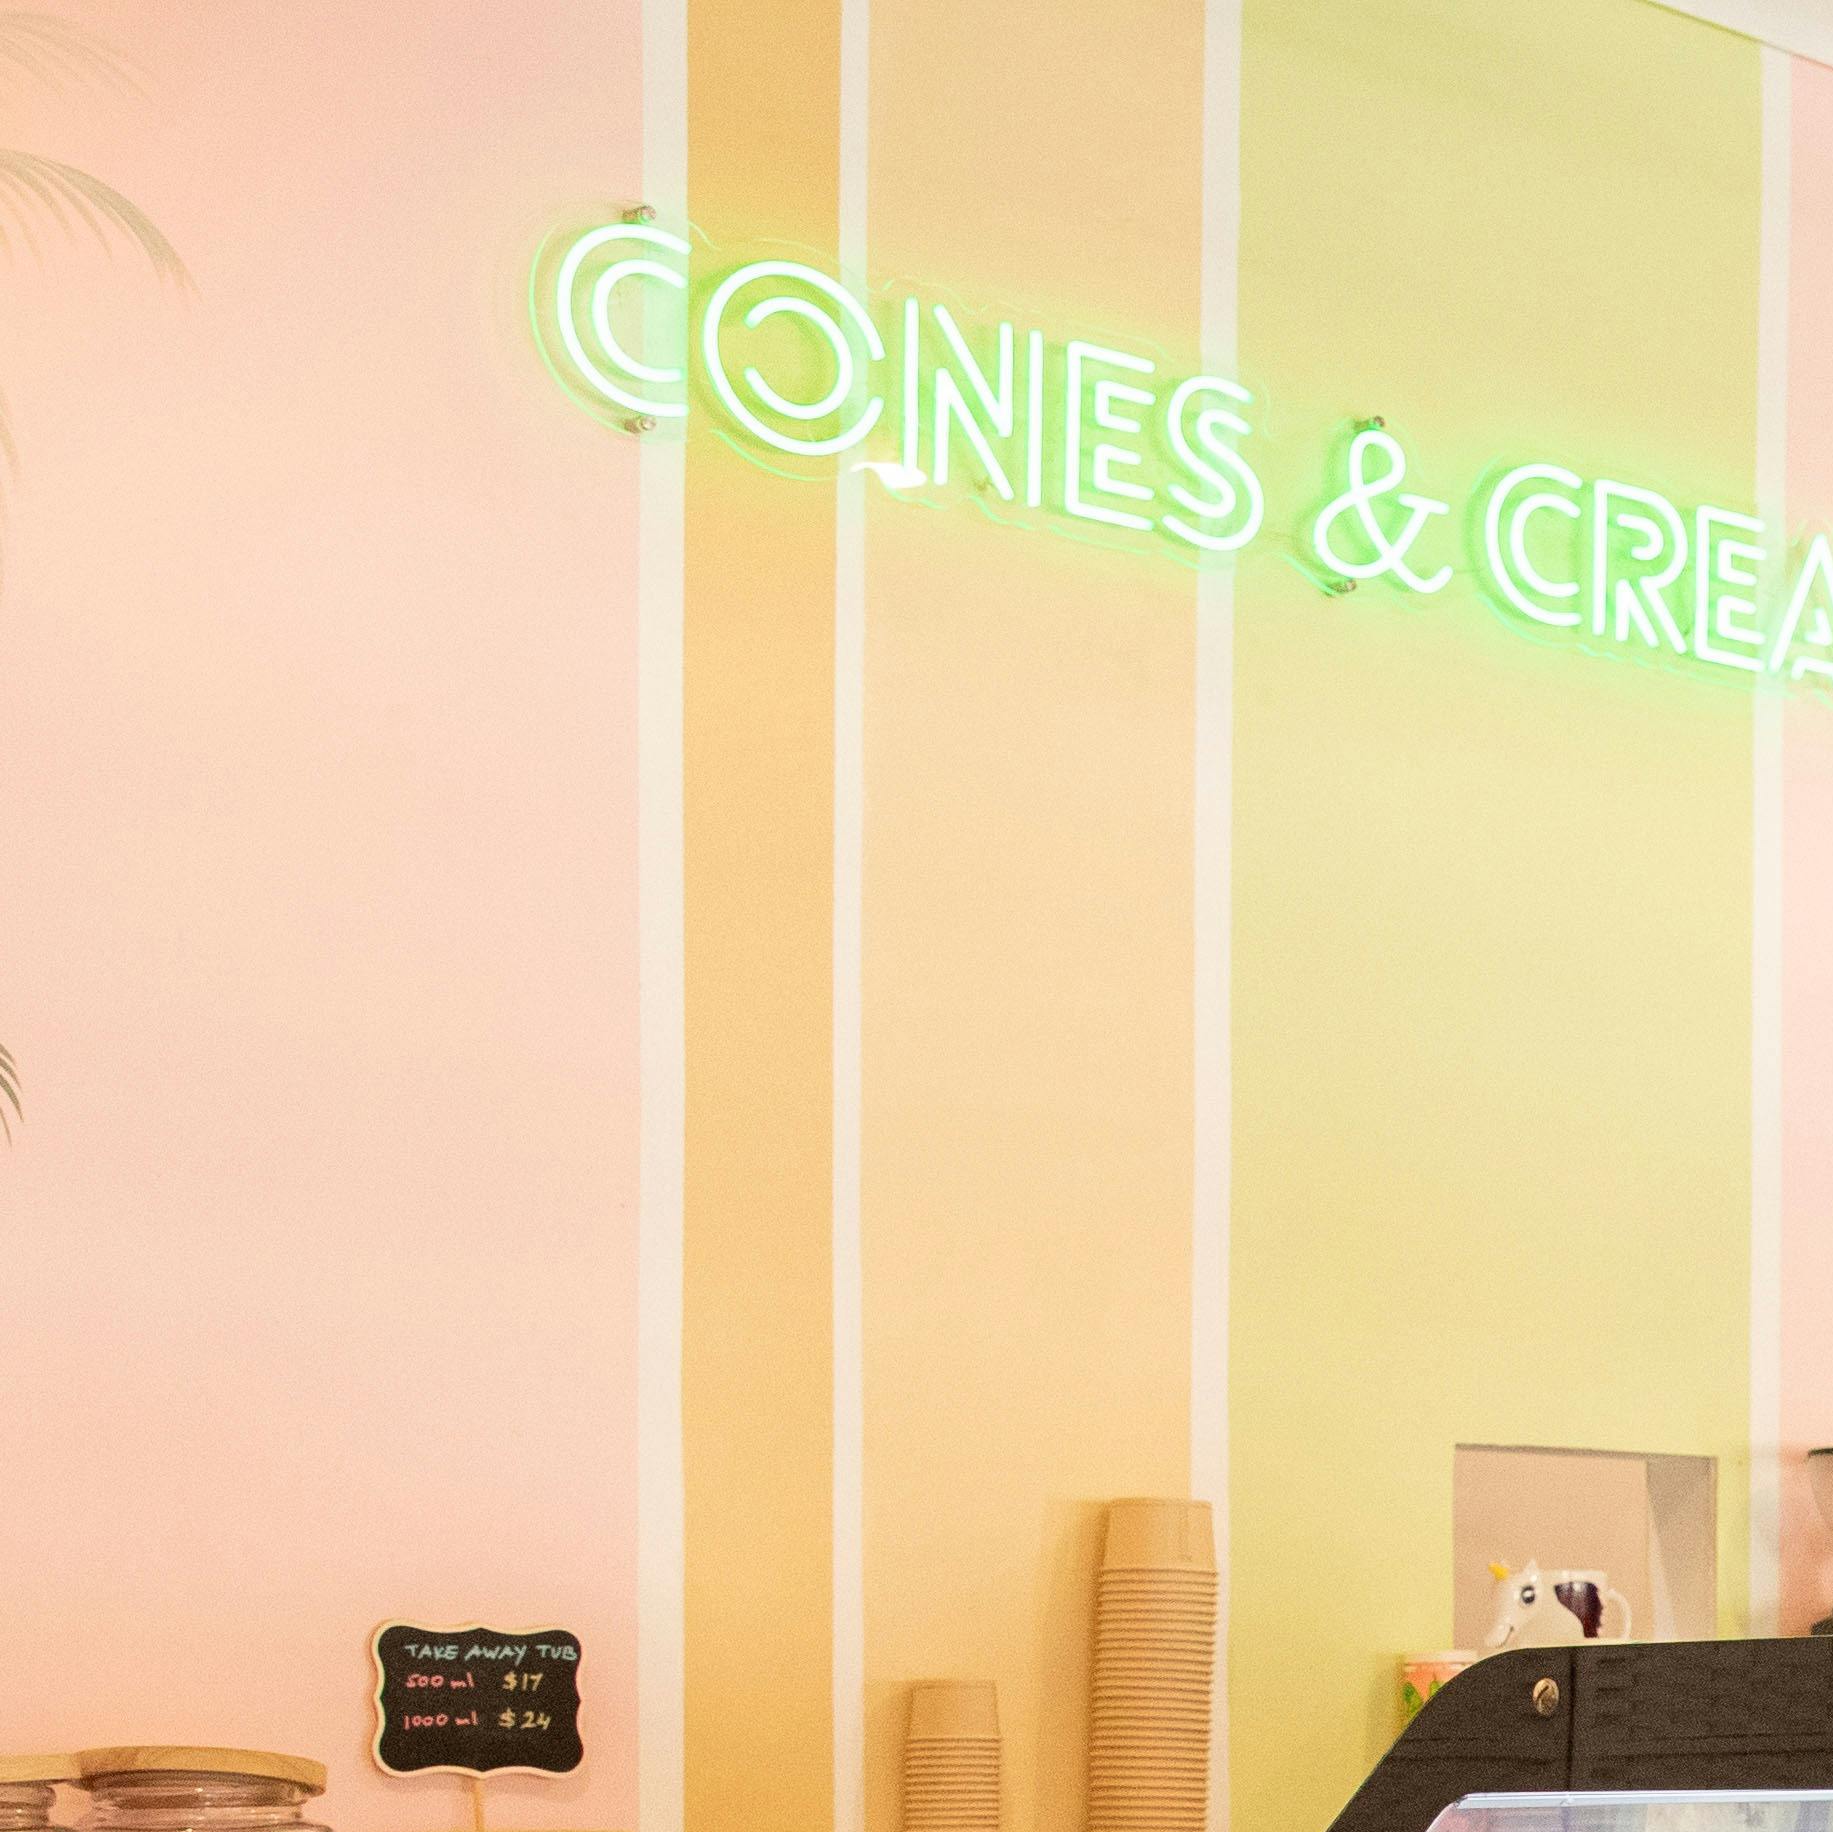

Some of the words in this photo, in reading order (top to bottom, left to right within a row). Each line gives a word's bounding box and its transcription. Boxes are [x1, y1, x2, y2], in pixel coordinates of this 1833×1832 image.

[556, 222, 1266, 551] CONES
[1313, 428, 1453, 594] &
[404, 1643, 460, 1661] TAKE
[464, 1643, 528, 1666] AWAY
[534, 1643, 579, 1661] TUB
[405, 1672, 445, 1690] 500
[450, 1670, 476, 1690] ml
[501, 1669, 545, 1693] $17
[403, 1711, 449, 1731] 1000
[454, 1709, 479, 1727] ml
